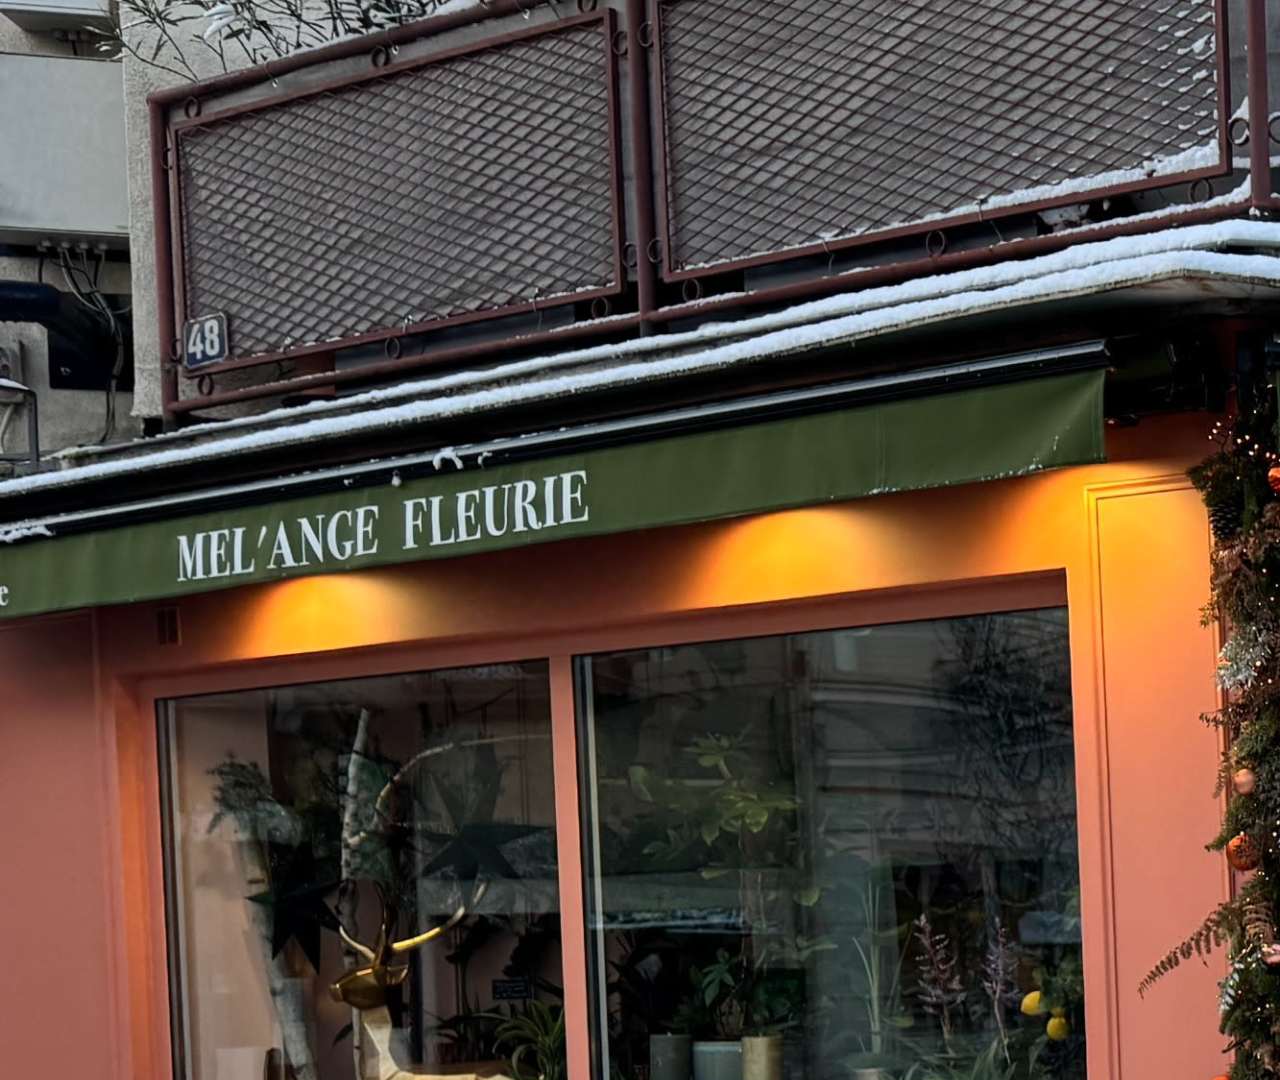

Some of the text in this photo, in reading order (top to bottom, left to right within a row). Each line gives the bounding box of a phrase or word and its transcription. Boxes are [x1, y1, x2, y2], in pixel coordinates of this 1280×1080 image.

[188, 319, 220, 360] 48
[177, 469, 589, 582] MEL'ANGE FLEURIE
